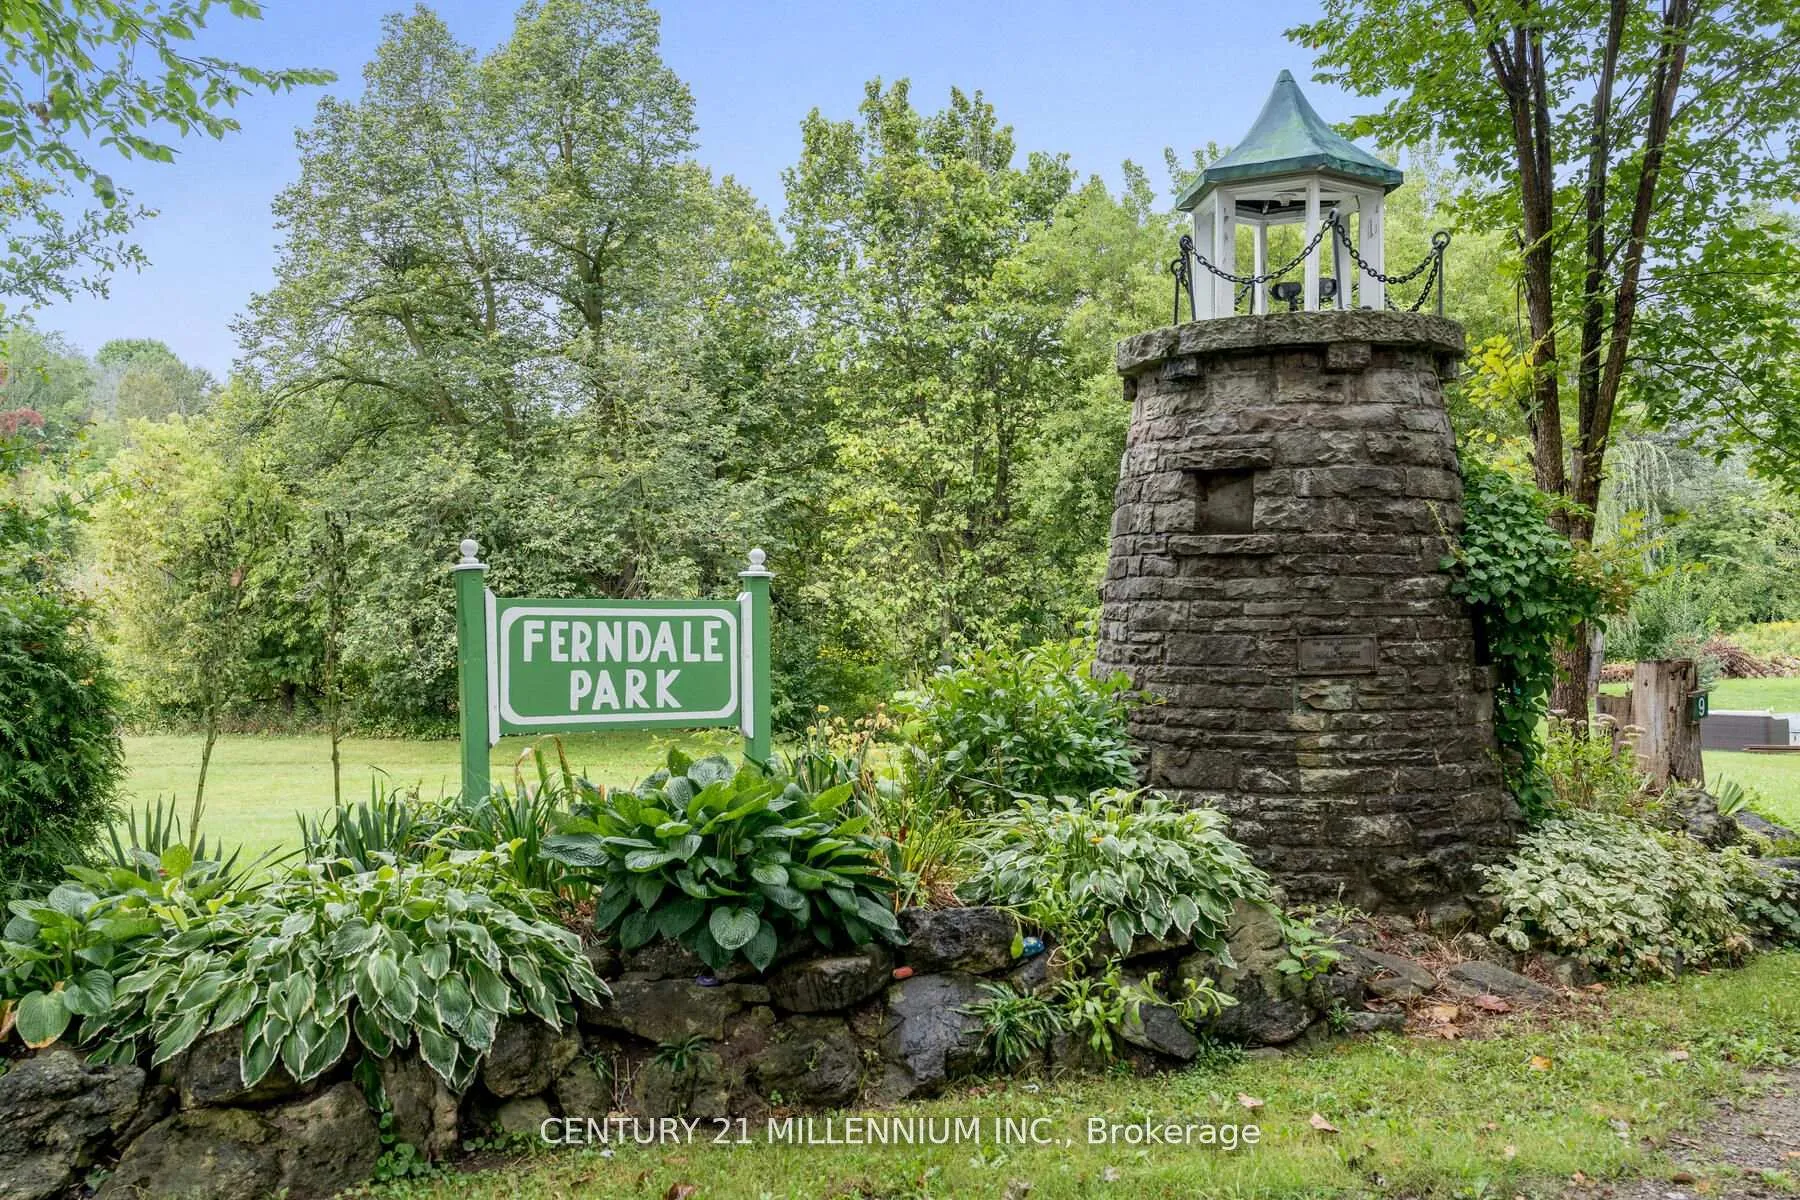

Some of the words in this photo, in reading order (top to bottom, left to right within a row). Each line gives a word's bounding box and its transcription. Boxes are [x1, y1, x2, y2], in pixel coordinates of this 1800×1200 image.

[523, 620, 724, 662] FERNDALE
[570, 669, 682, 711] PARK
[1698, 696, 1705, 716] 9
